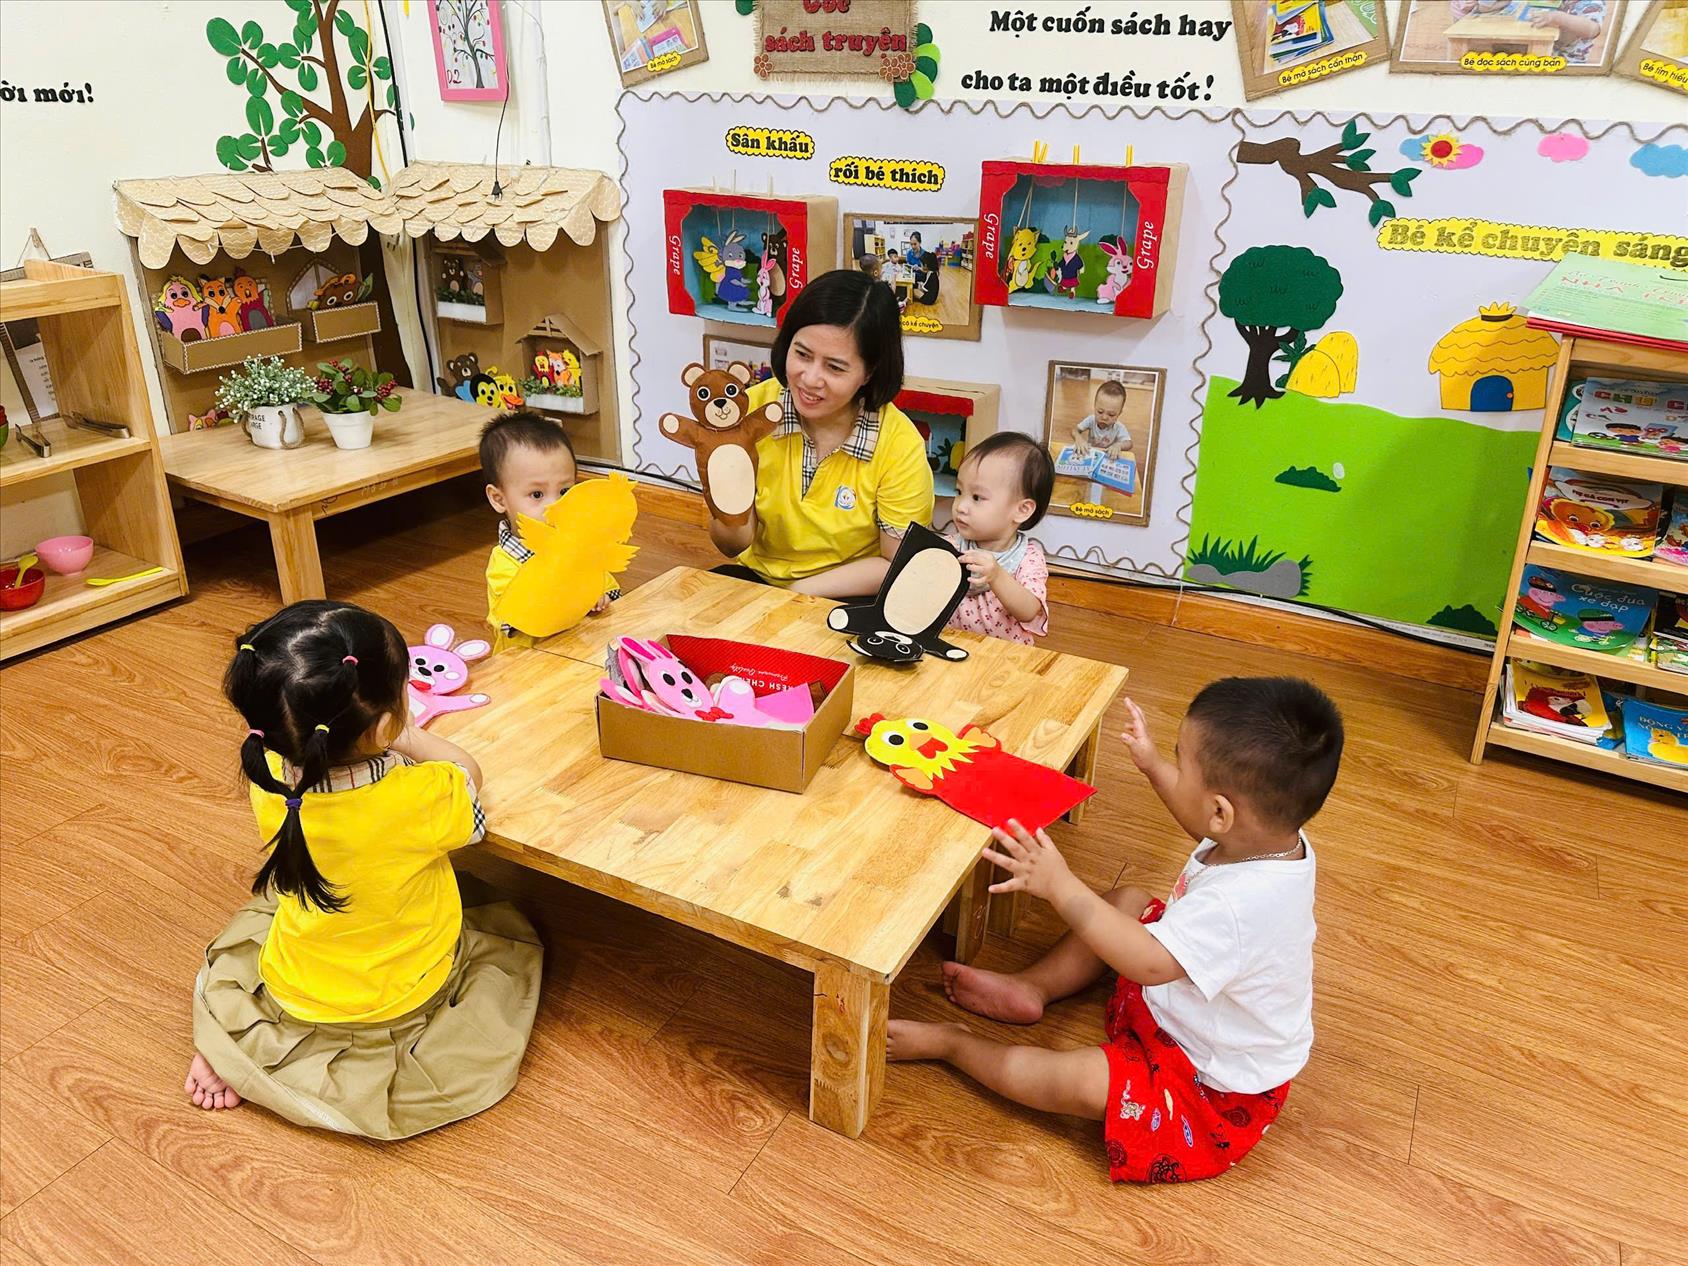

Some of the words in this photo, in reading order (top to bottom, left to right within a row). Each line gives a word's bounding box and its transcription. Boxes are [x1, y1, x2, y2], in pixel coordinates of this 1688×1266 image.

[989, 10, 1038, 38] Một
[1042, 6, 1105, 34] cuốn
[1111, 12, 1171, 36] sách
[1178, 14, 1232, 41] hay
[765, 26, 816, 52] sách
[822, 26, 907, 59] truyện
[1281, 74, 1292, 84] Bé
[1308, 64, 1327, 76] sách
[1464, 57, 1475, 66] Bé
[1496, 57, 1517, 66] sách
[1518, 57, 1541, 68] cùng
[961, 70, 1004, 92] cho
[1008, 71, 1032, 92] ta
[1039, 73, 1089, 100] một
[1093, 70, 1151, 97] điều
[730, 133, 761, 149] Sân
[765, 134, 809, 153] khấu
[834, 162, 860, 181] rối
[864, 165, 885, 182] bé
[890, 166, 939, 185] thích
[985, 212, 1000, 260] Grape
[1136, 220, 1158, 270] Grape
[1387, 223, 1426, 246] Bé
[1434, 222, 1478, 249] kể
[1481, 228, 1601, 257] chuyện
[1613, 236, 1688, 268] sáng
[668, 235, 682, 275] Grape
[789, 247, 802, 289] Grape
